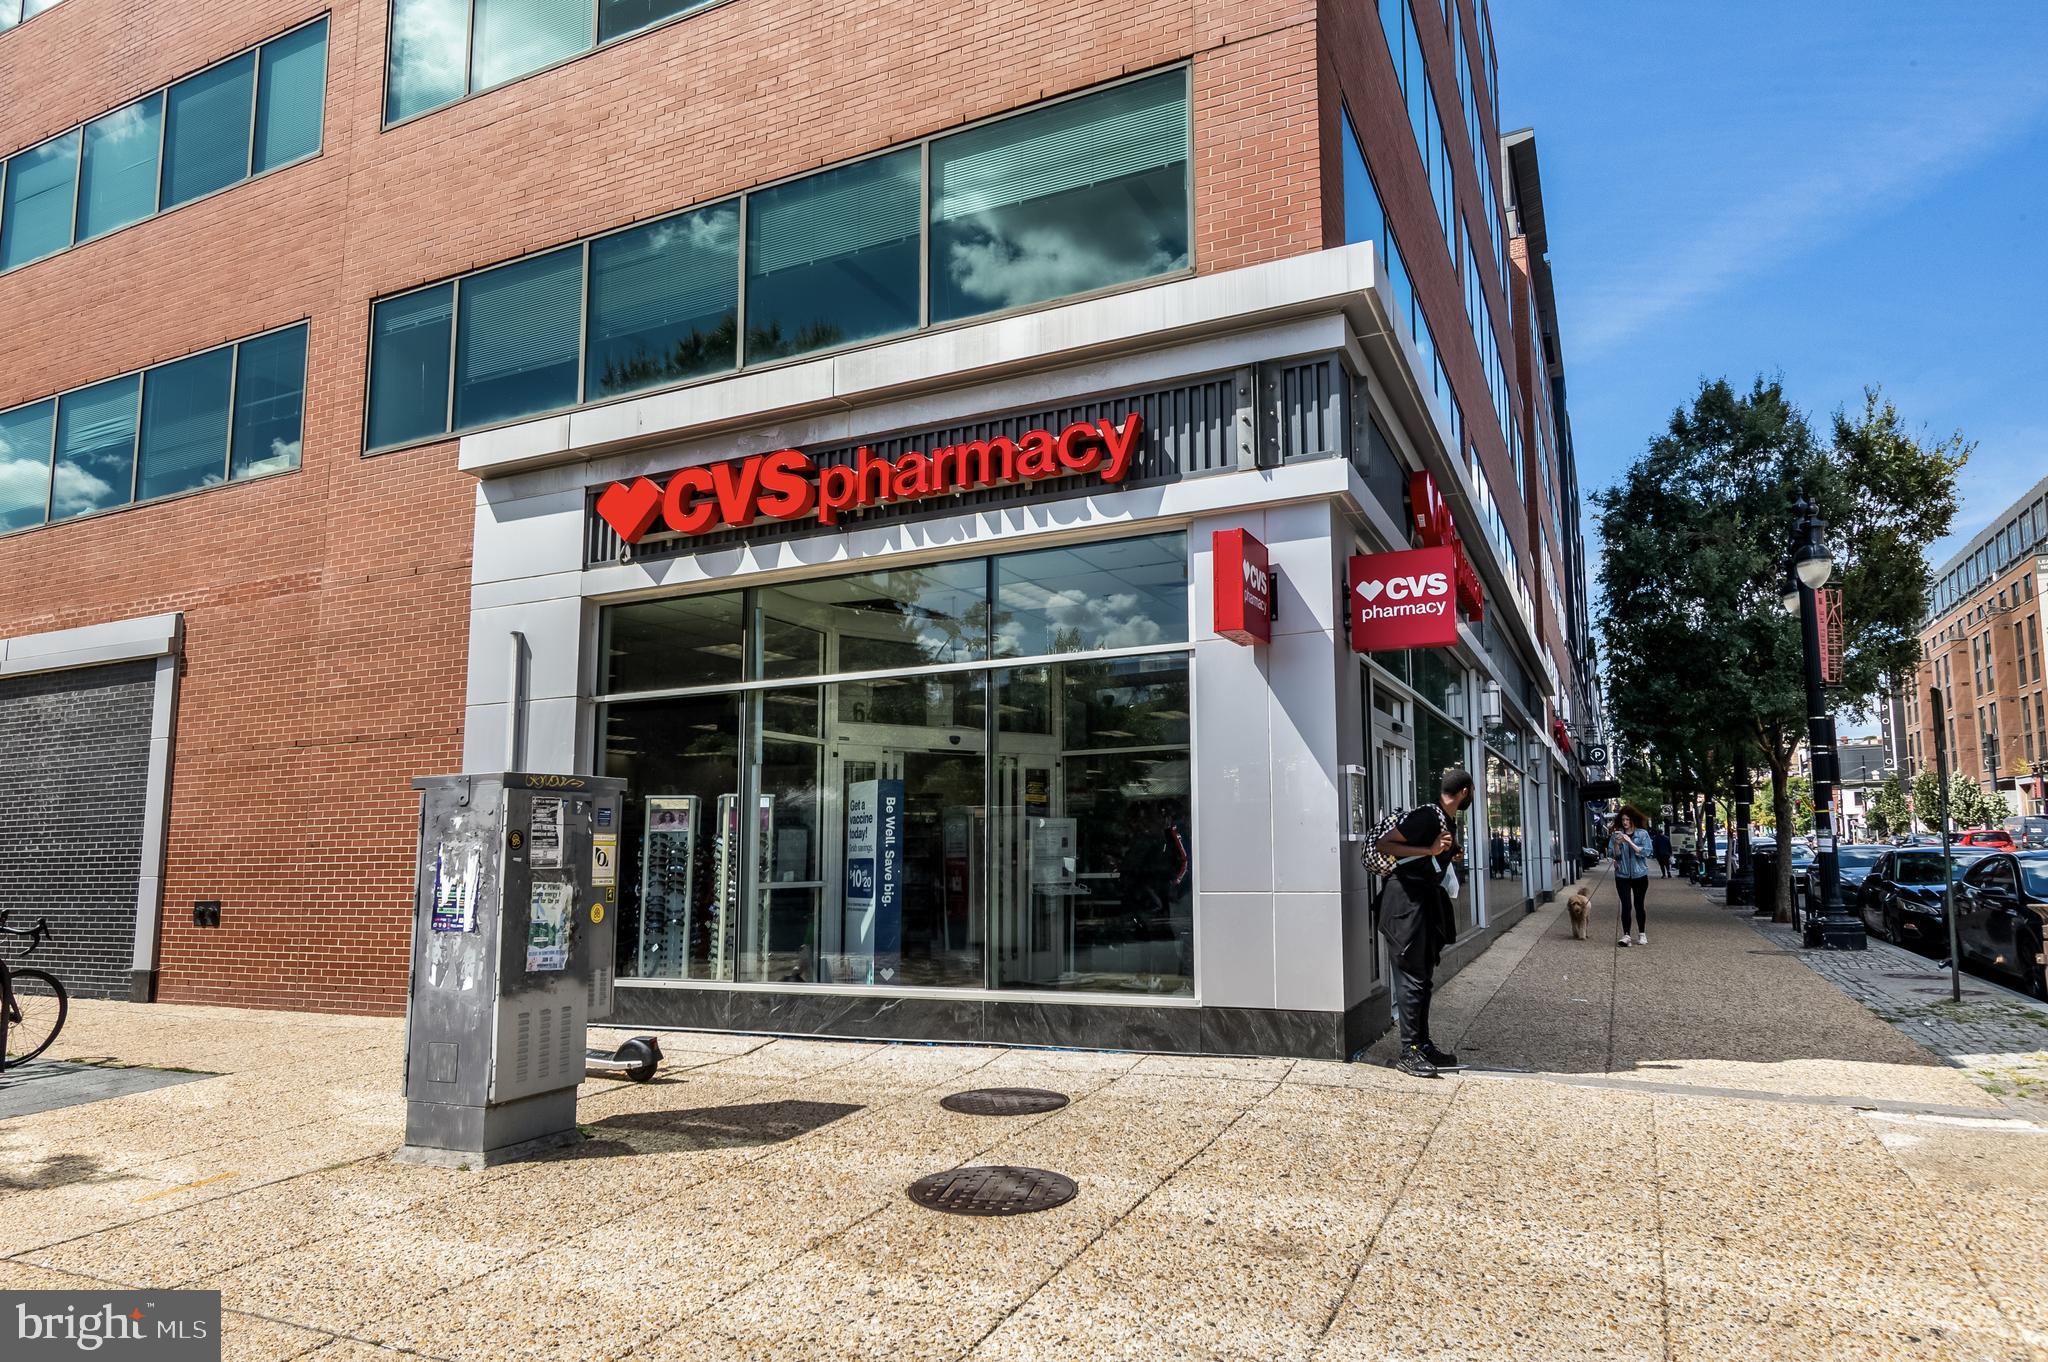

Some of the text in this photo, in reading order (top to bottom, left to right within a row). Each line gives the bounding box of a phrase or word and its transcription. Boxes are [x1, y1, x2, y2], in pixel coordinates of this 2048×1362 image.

[661, 411, 1143, 535] CVS pharmacy
[1249, 563, 1268, 595] CVS
[1385, 572, 1448, 600] CVS
[1243, 589, 1267, 615] pharmacy
[1361, 599, 1446, 622] pharmacy
[849, 812, 873, 825] vaccine
[850, 799, 860, 812] Get
[849, 826, 868, 841] today!
[881, 796, 896, 908] Be Well. Save big.
